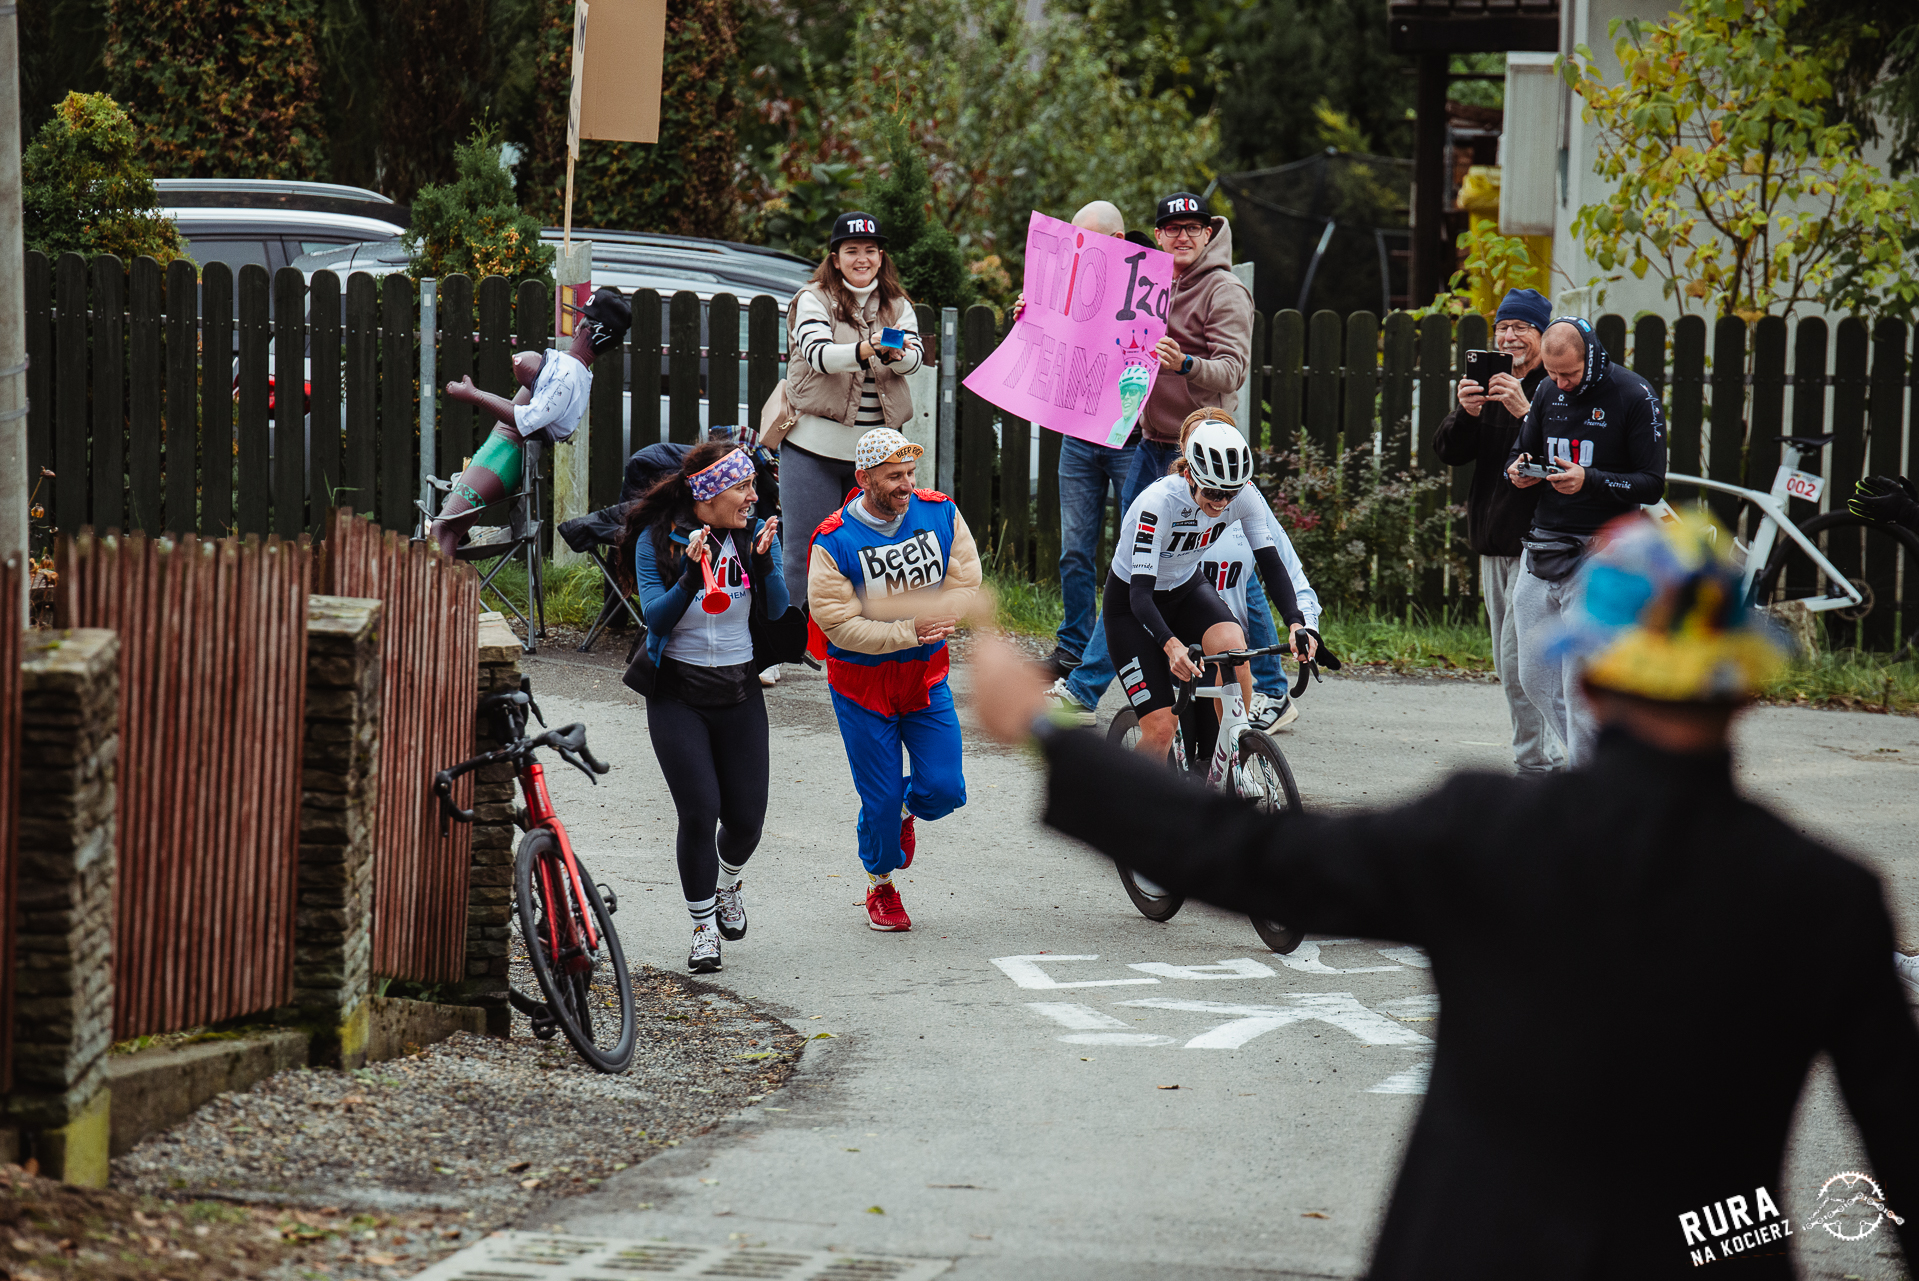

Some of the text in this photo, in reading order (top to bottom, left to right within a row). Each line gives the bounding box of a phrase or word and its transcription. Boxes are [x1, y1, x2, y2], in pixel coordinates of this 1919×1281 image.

[1003, 321, 1108, 416] TEAM
[1787, 477, 1816, 498] 002
[1199, 560, 1243, 592] RiO
